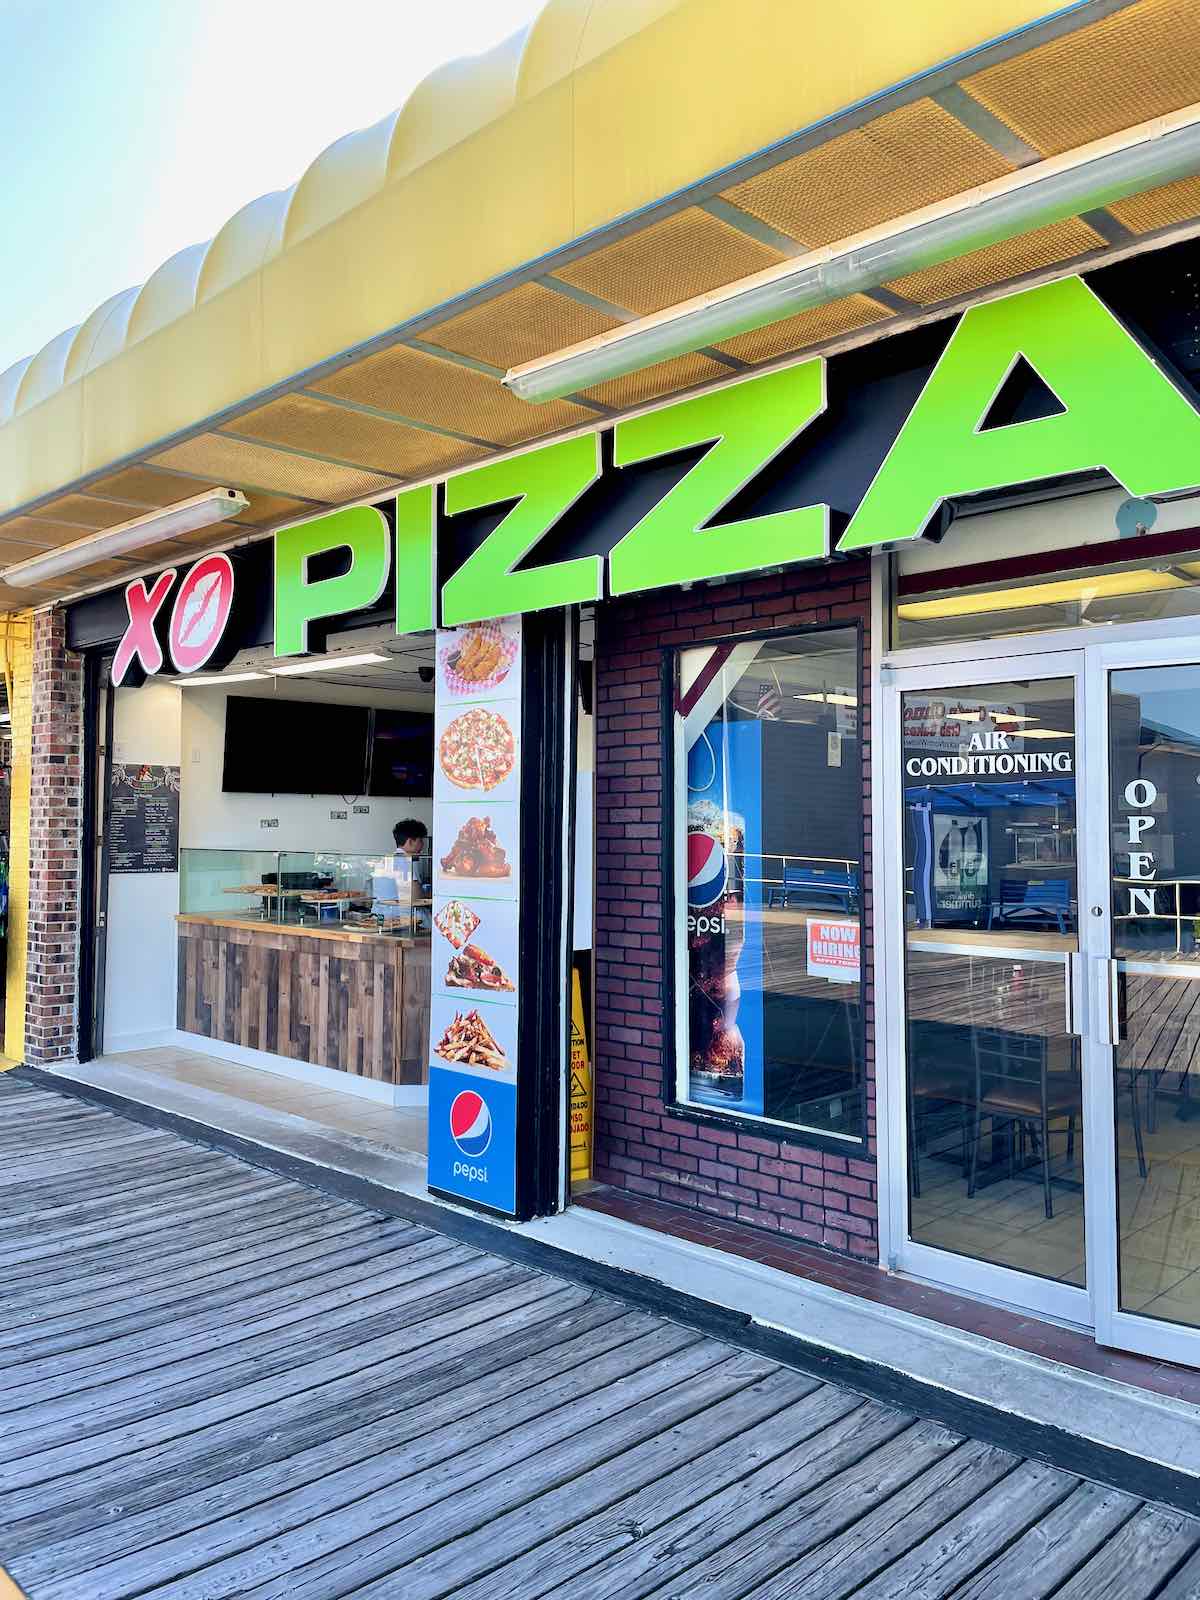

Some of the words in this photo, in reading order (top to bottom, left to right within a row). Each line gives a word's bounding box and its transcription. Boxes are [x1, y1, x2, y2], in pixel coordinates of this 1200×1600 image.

[112, 552, 234, 687] XO
[274, 274, 1200, 657] PIZZA
[968, 731, 1009, 751] AIR
[906, 752, 1072, 776] CONDITIONING
[1125, 779, 1157, 916] OPEN
[688, 913, 725, 936] epsi
[820, 927, 856, 942] NOW
[571, 1060, 585, 1070] OOR
[453, 1161, 489, 1183] pepsi
